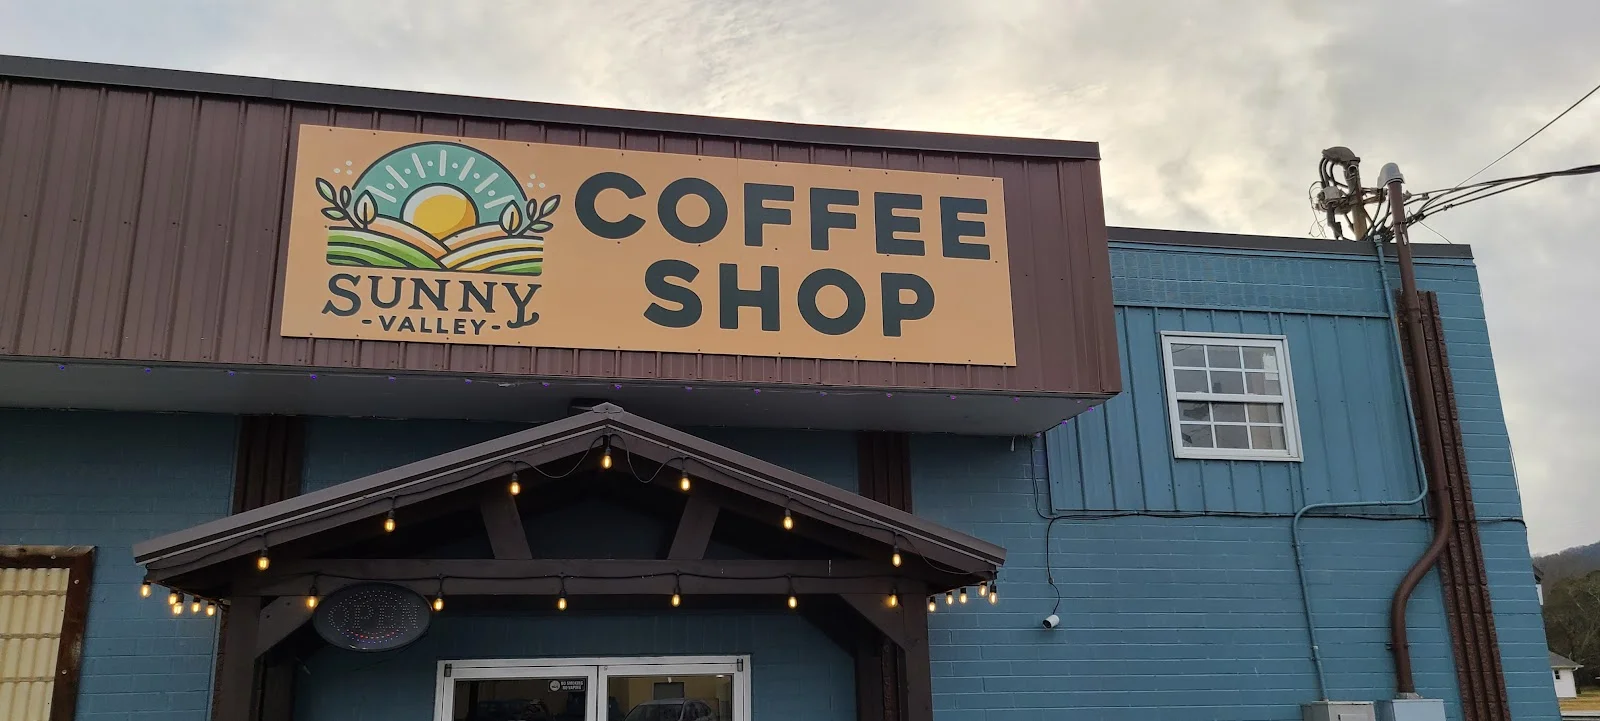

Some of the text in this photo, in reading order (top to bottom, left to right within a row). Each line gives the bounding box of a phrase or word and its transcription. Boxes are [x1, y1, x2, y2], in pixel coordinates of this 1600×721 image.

[574, 171, 991, 260] COFFEE
[321, 273, 543, 329] SUNNY
[643, 259, 935, 338] SHOP
[328, 604, 420, 630] OPEN
